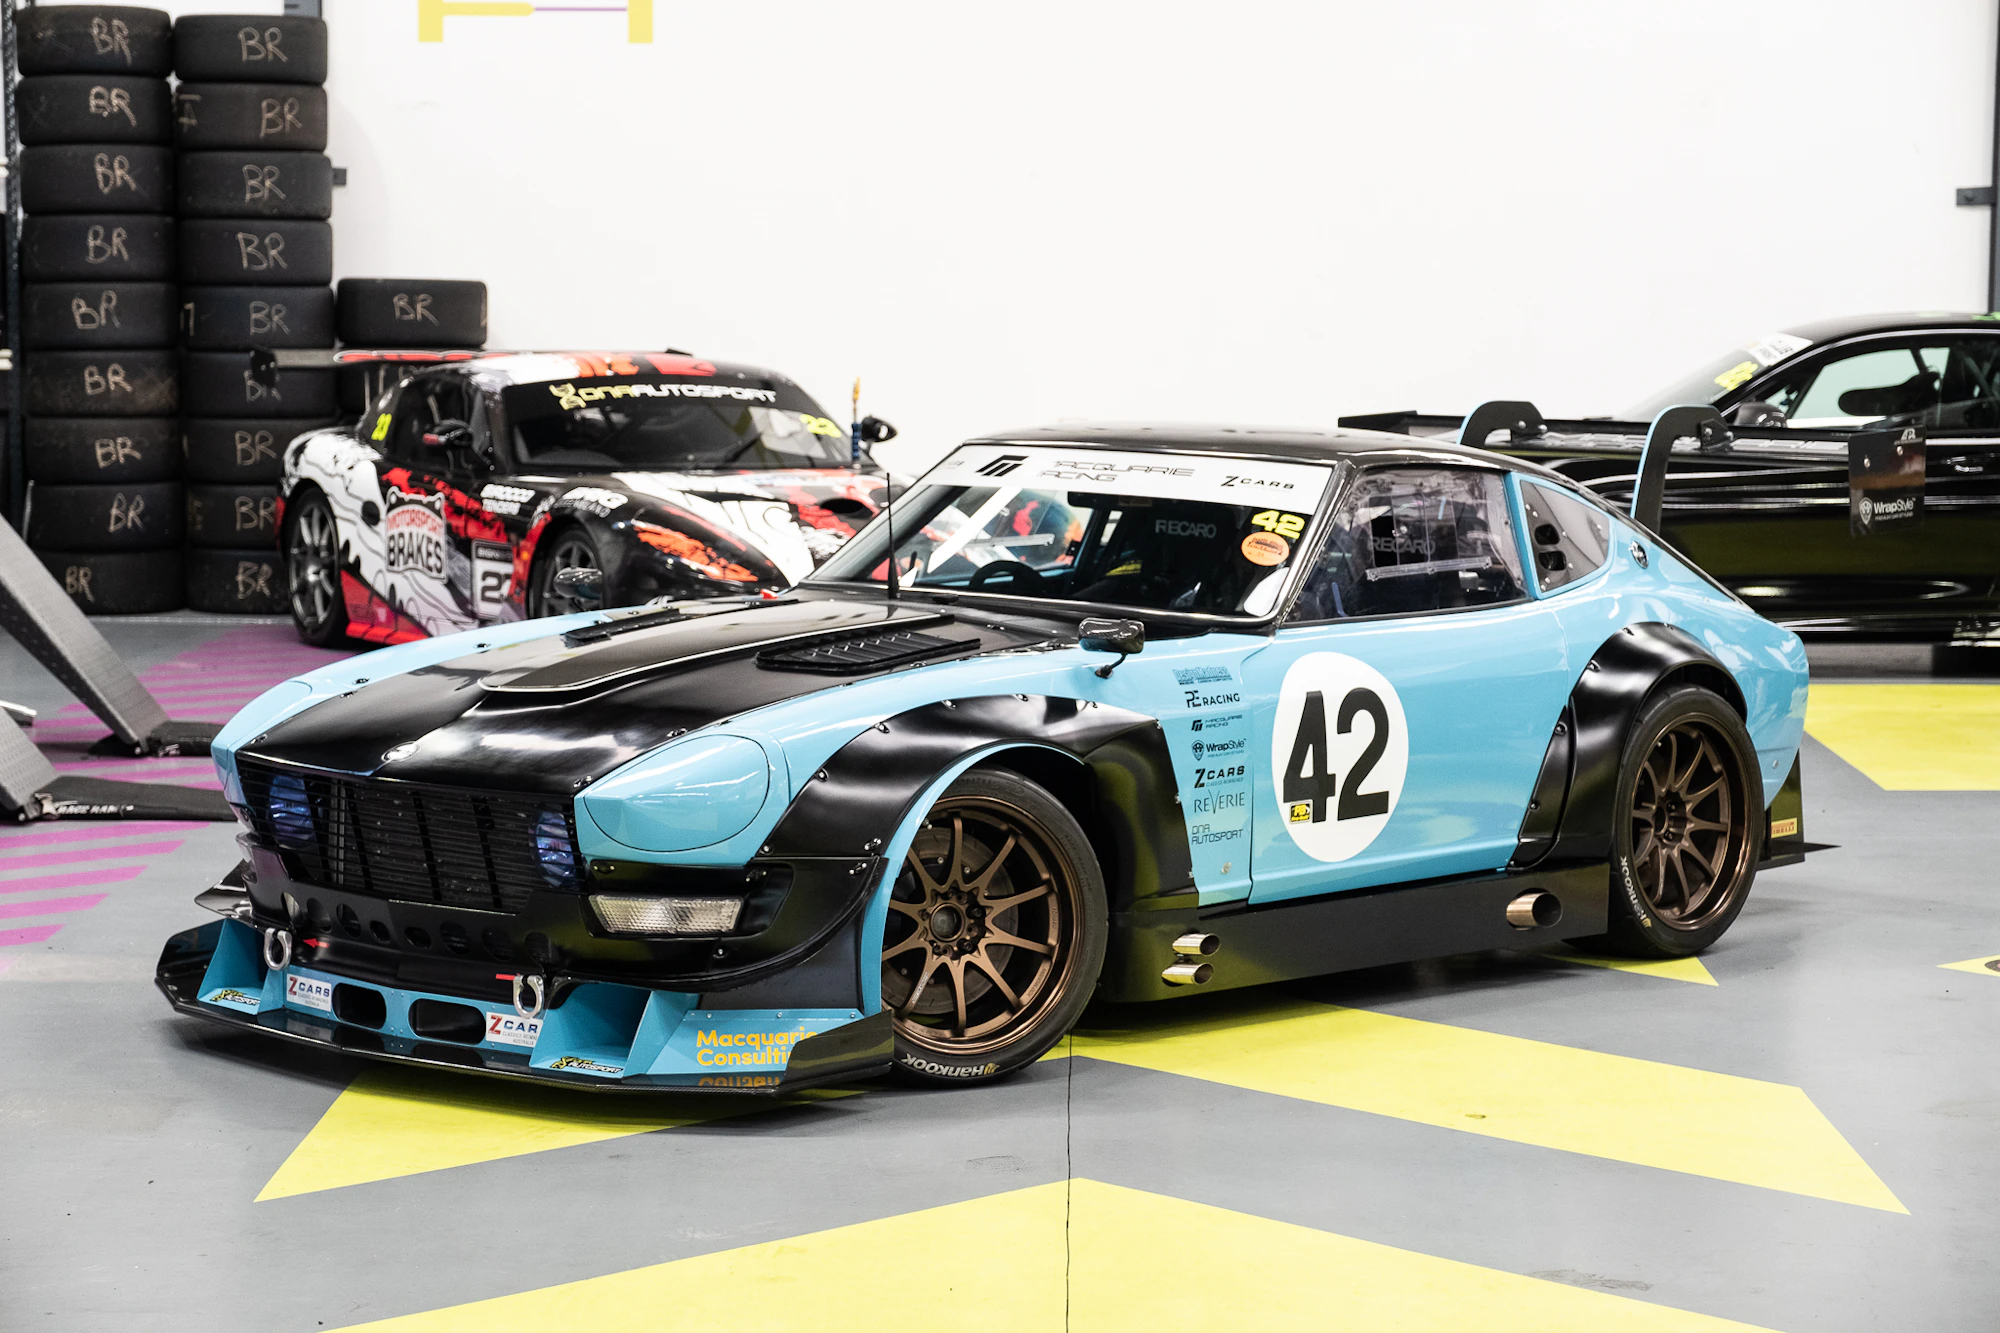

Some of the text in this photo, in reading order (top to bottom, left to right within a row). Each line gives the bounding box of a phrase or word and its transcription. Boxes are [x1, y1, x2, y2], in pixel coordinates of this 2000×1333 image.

[92, 17, 132, 66] BR
[238, 27, 288, 63] BR
[89, 86, 136, 127] BR
[261, 98, 302, 138] BR
[95, 153, 136, 194] BR
[243, 165, 286, 203] BR
[86, 225, 129, 263] BR
[237, 232, 287, 271] BR
[71, 291, 120, 329] BR
[249, 300, 291, 335] BR
[392, 293, 440, 327] BR
[84, 364, 133, 395] BR
[95, 437, 141, 468] BR
[235, 431, 278, 466] BR
[108, 493, 145, 533] BR
[235, 496, 276, 531] BR
[1873, 499, 1914, 514] WrapStyle
[1156, 519, 1217, 538] RECARO
[1251, 510, 1305, 540] 42
[388, 532, 443, 574] BRAKES
[1367, 536, 1436, 555] RECARO
[65, 566, 95, 602] BR
[235, 561, 272, 599] BR
[1202, 693, 1240, 706] RACING
[1206, 740, 1245, 752] WrapStyle
[1283, 687, 1389, 823] 42
[1207, 766, 1244, 780] CARS
[1194, 789, 1245, 814] REVERIE
[1192, 829, 1244, 844] AUTOSPORT
[288, 977, 330, 998] Z CARS
[488, 1015, 538, 1035] Z CAR
[568, 1061, 622, 1073] AUTOSPORT
